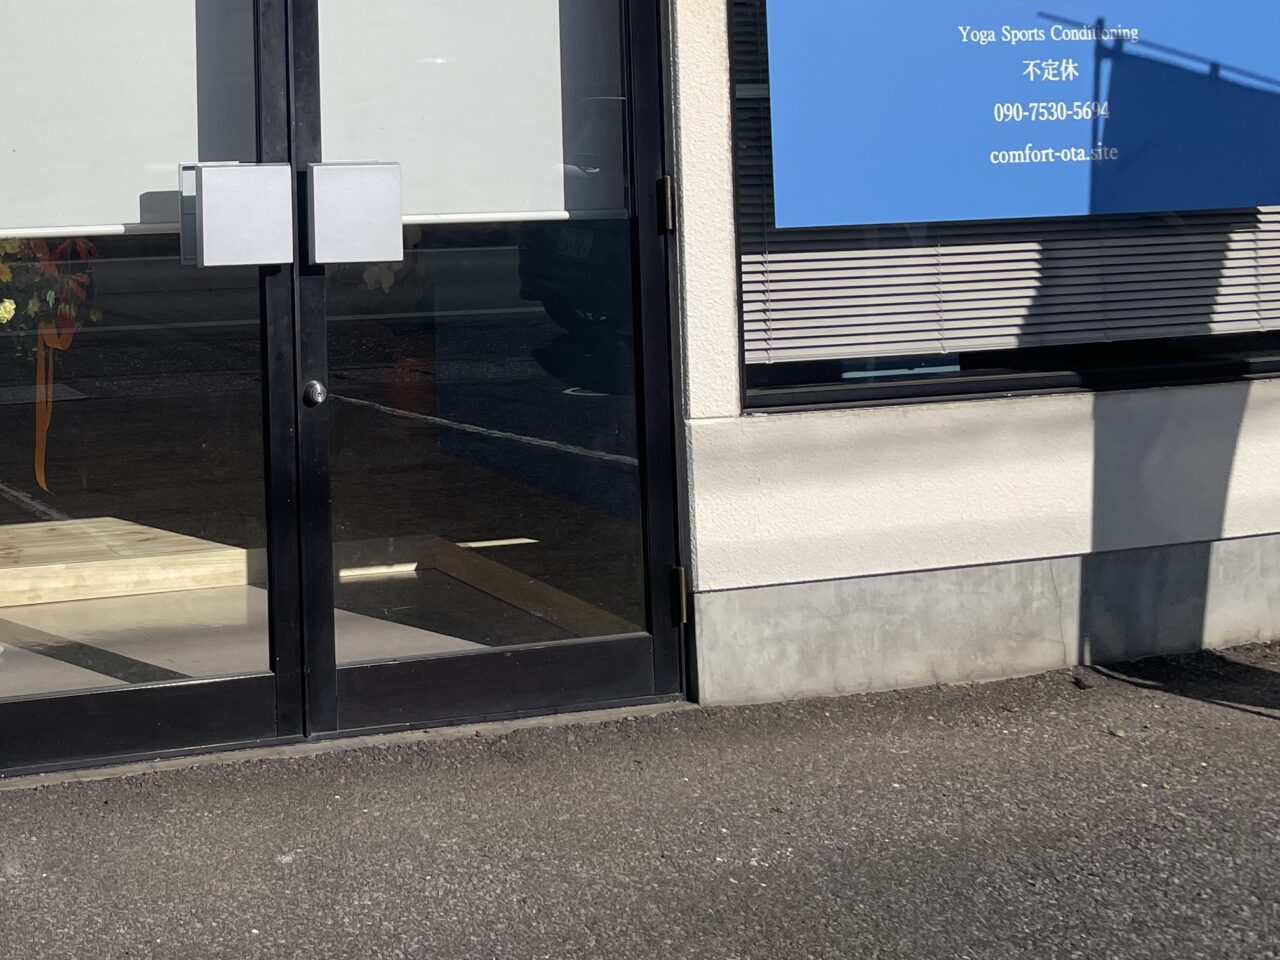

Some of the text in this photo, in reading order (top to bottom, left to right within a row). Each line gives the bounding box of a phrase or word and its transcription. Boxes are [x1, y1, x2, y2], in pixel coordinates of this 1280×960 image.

[958, 24, 1139, 45] Yoga Sports Conditioning
[1022, 59, 1079, 81] 不定休
[994, 101, 1111, 122] 090-7530-5694
[990, 142, 1118, 164] comfort-ota.site
